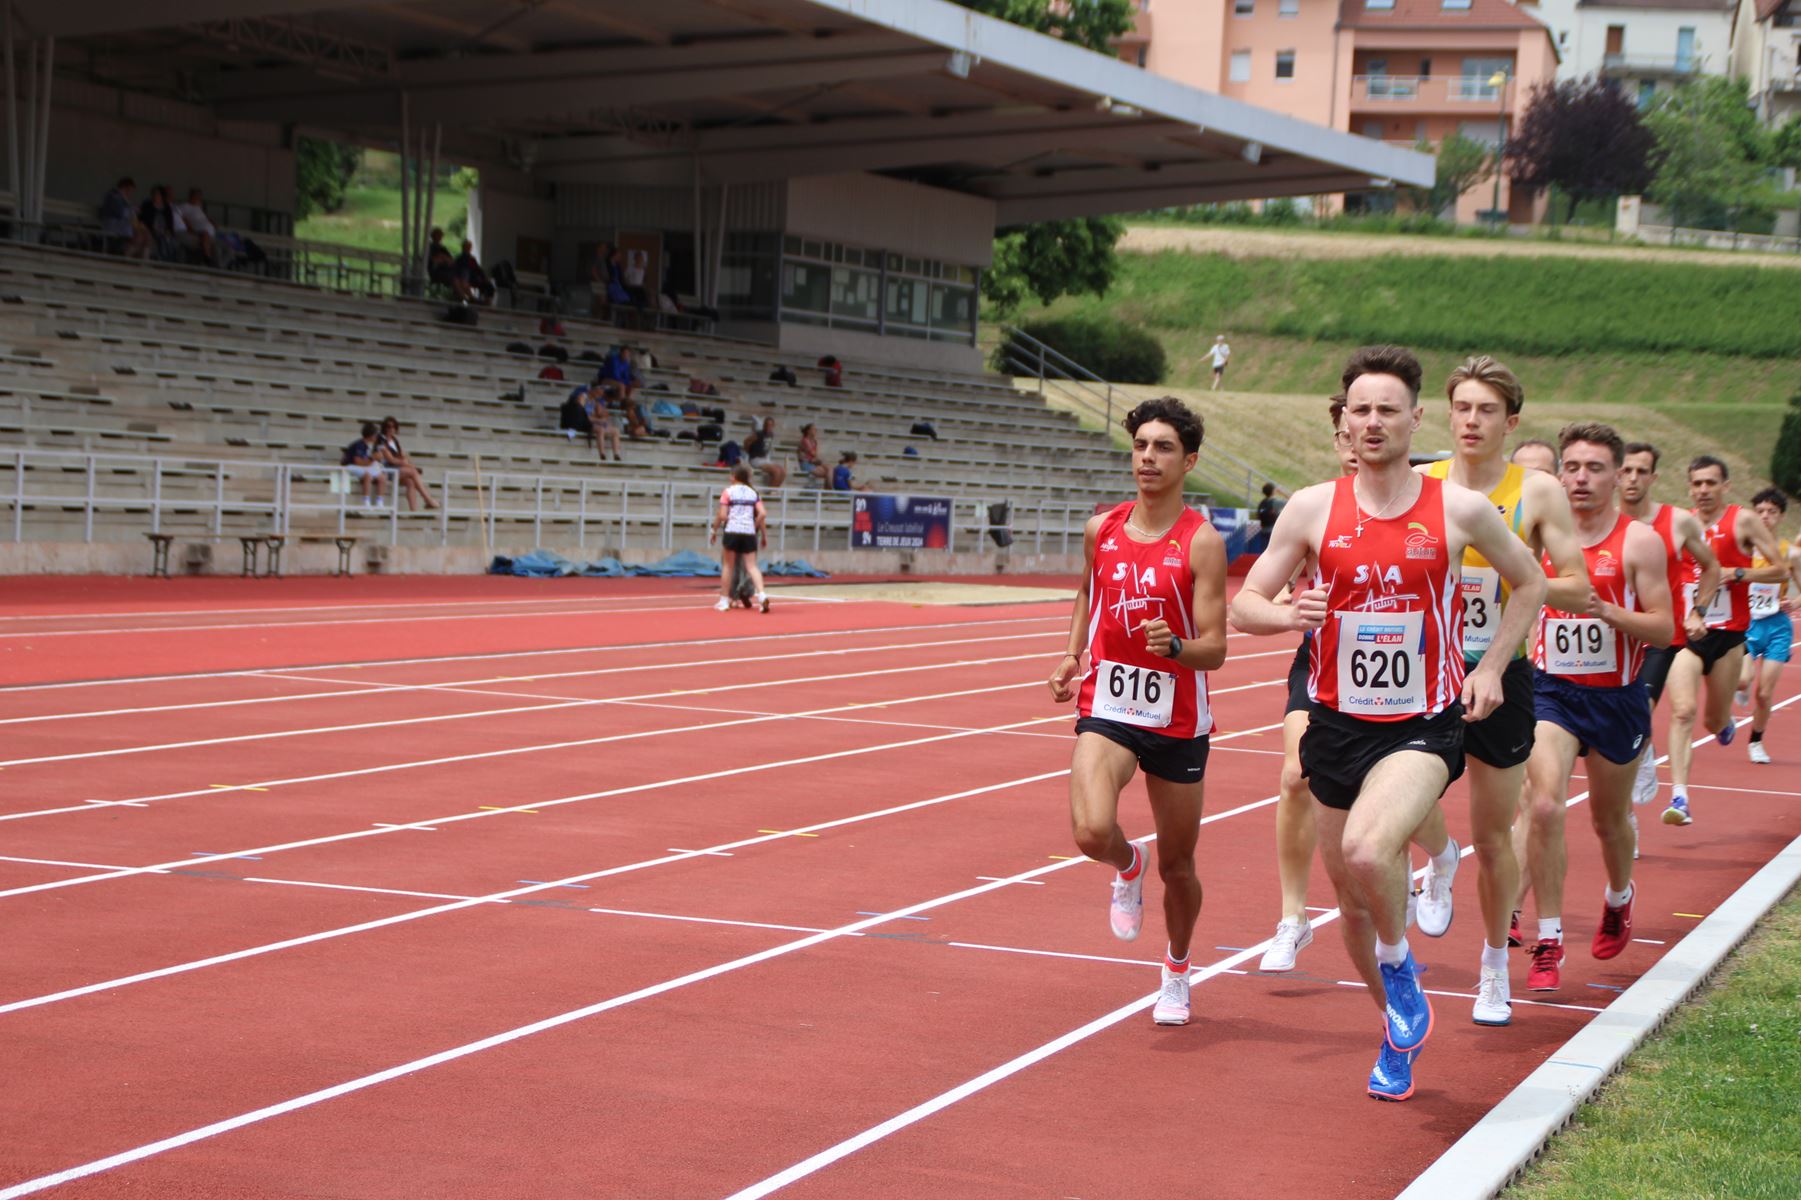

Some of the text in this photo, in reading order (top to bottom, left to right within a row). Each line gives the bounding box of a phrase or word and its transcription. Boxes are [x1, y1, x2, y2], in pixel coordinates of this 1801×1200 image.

[1376, 634, 1403, 642] L'ÉLAN
[1555, 623, 1602, 654] 619
[1351, 649, 1410, 688] 620
[1109, 664, 1161, 704] 616
[1103, 704, 1160, 720] Crédit Mutuel
[1348, 696, 1414, 706] Crédit Mutuel
